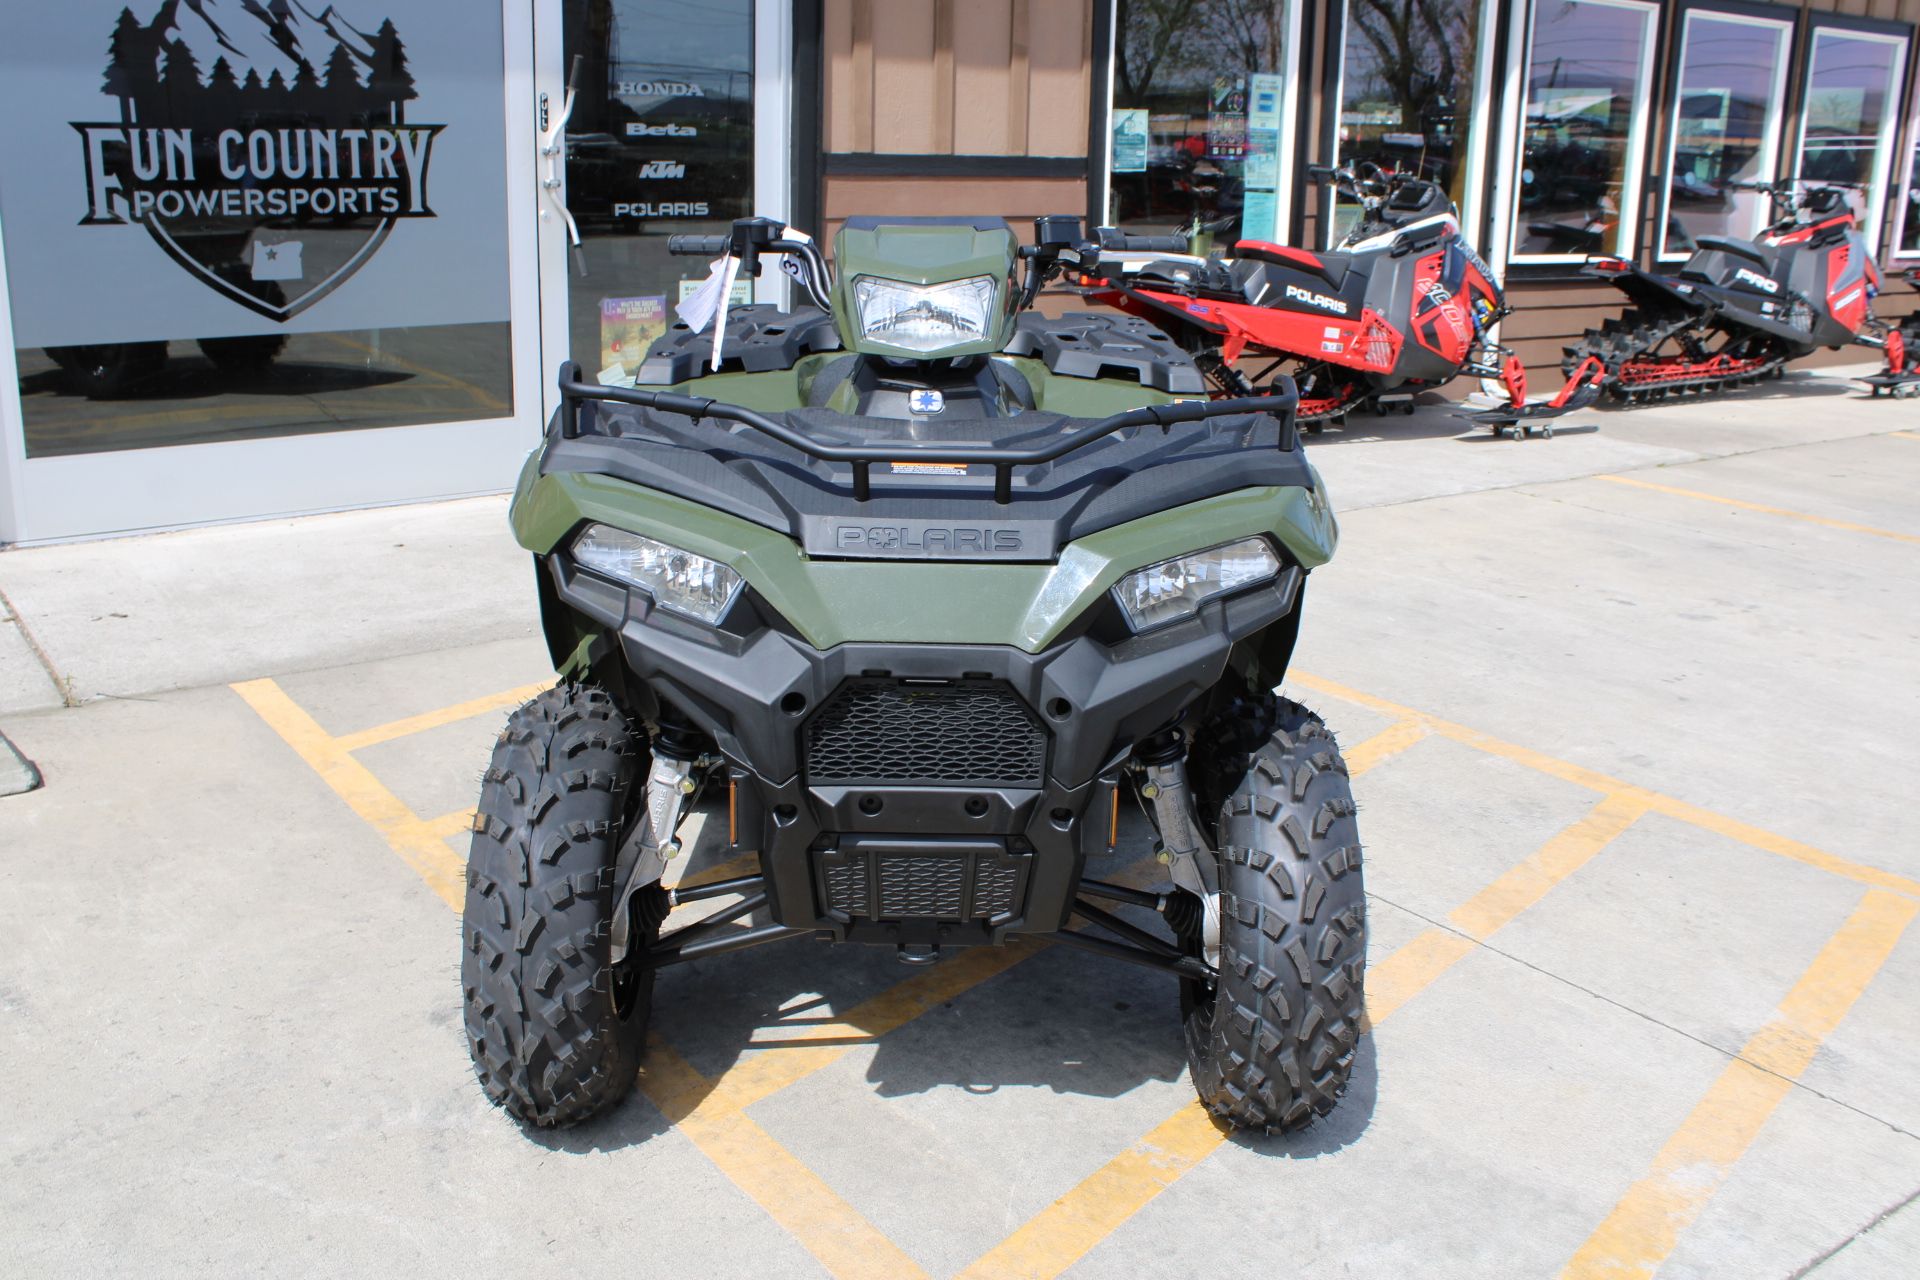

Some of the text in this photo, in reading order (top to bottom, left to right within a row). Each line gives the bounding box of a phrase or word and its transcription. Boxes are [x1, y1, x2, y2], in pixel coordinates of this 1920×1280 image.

[617, 81, 704, 97] HONDA
[626, 122, 697, 136] Beta
[87, 128, 430, 219] FUN COUNTRY
[639, 160, 686, 179] KTM
[134, 185, 399, 218] POWERSPORTS
[614, 202, 709, 217] POLARIS
[1735, 267, 1779, 293] PRO
[1286, 285, 1347, 314] POLARIS
[837, 526, 1023, 551] POLARIS
